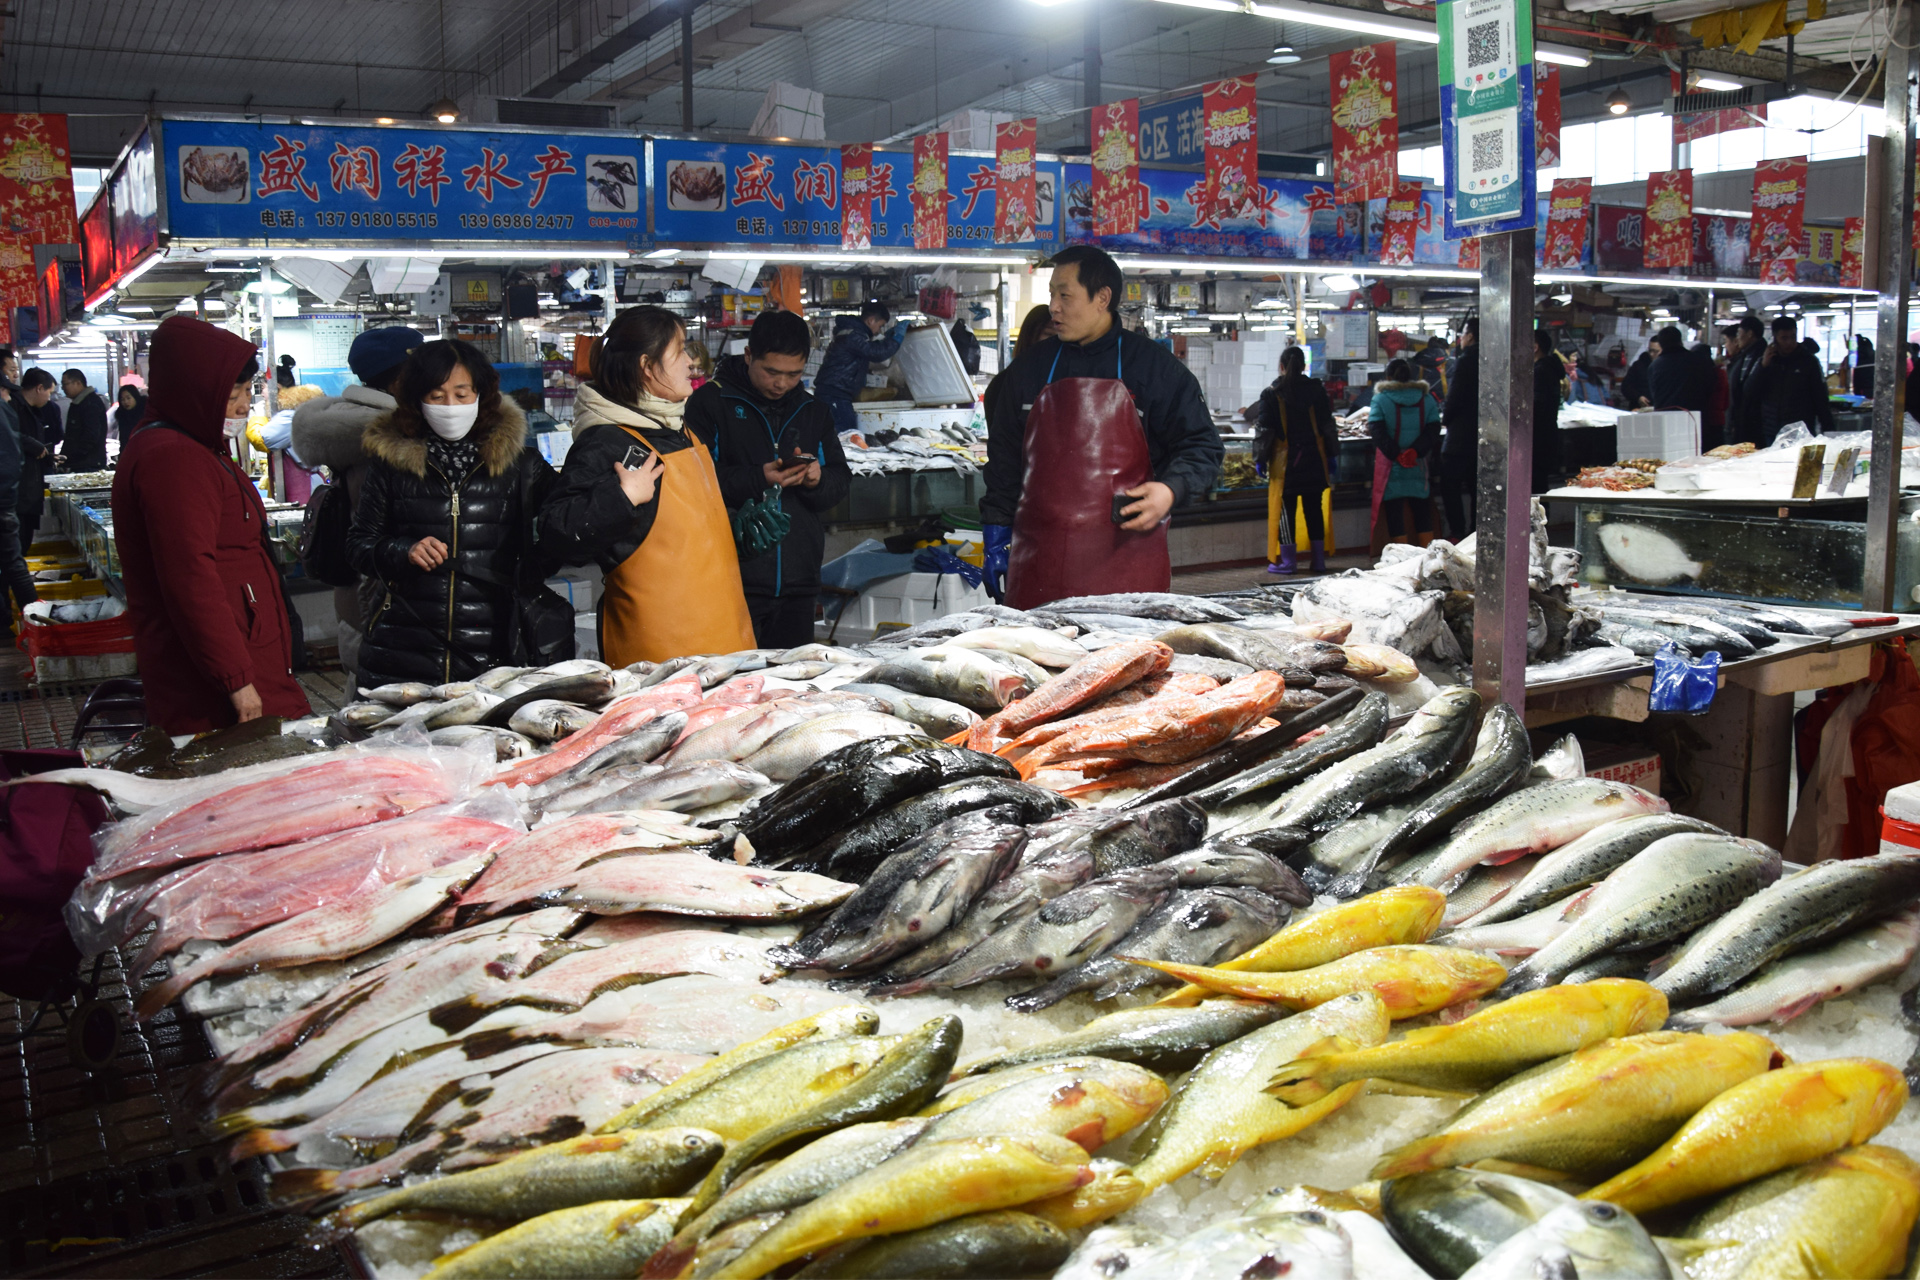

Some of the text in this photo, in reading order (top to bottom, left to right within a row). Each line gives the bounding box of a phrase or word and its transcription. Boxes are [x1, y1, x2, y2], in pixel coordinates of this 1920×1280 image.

[257, 134, 577, 208] 盛润祥水产
[315, 212, 346, 227] 137
[351, 212, 393, 227] 9180
[397, 213, 438, 228] 5515
[459, 214, 488, 229] 139
[493, 214, 532, 229] 6986
[536, 215, 574, 229] 2477
[588, 217, 639, 228] C09-007
[783, 219, 809, 235] 137
[812, 221, 842, 236] 918
